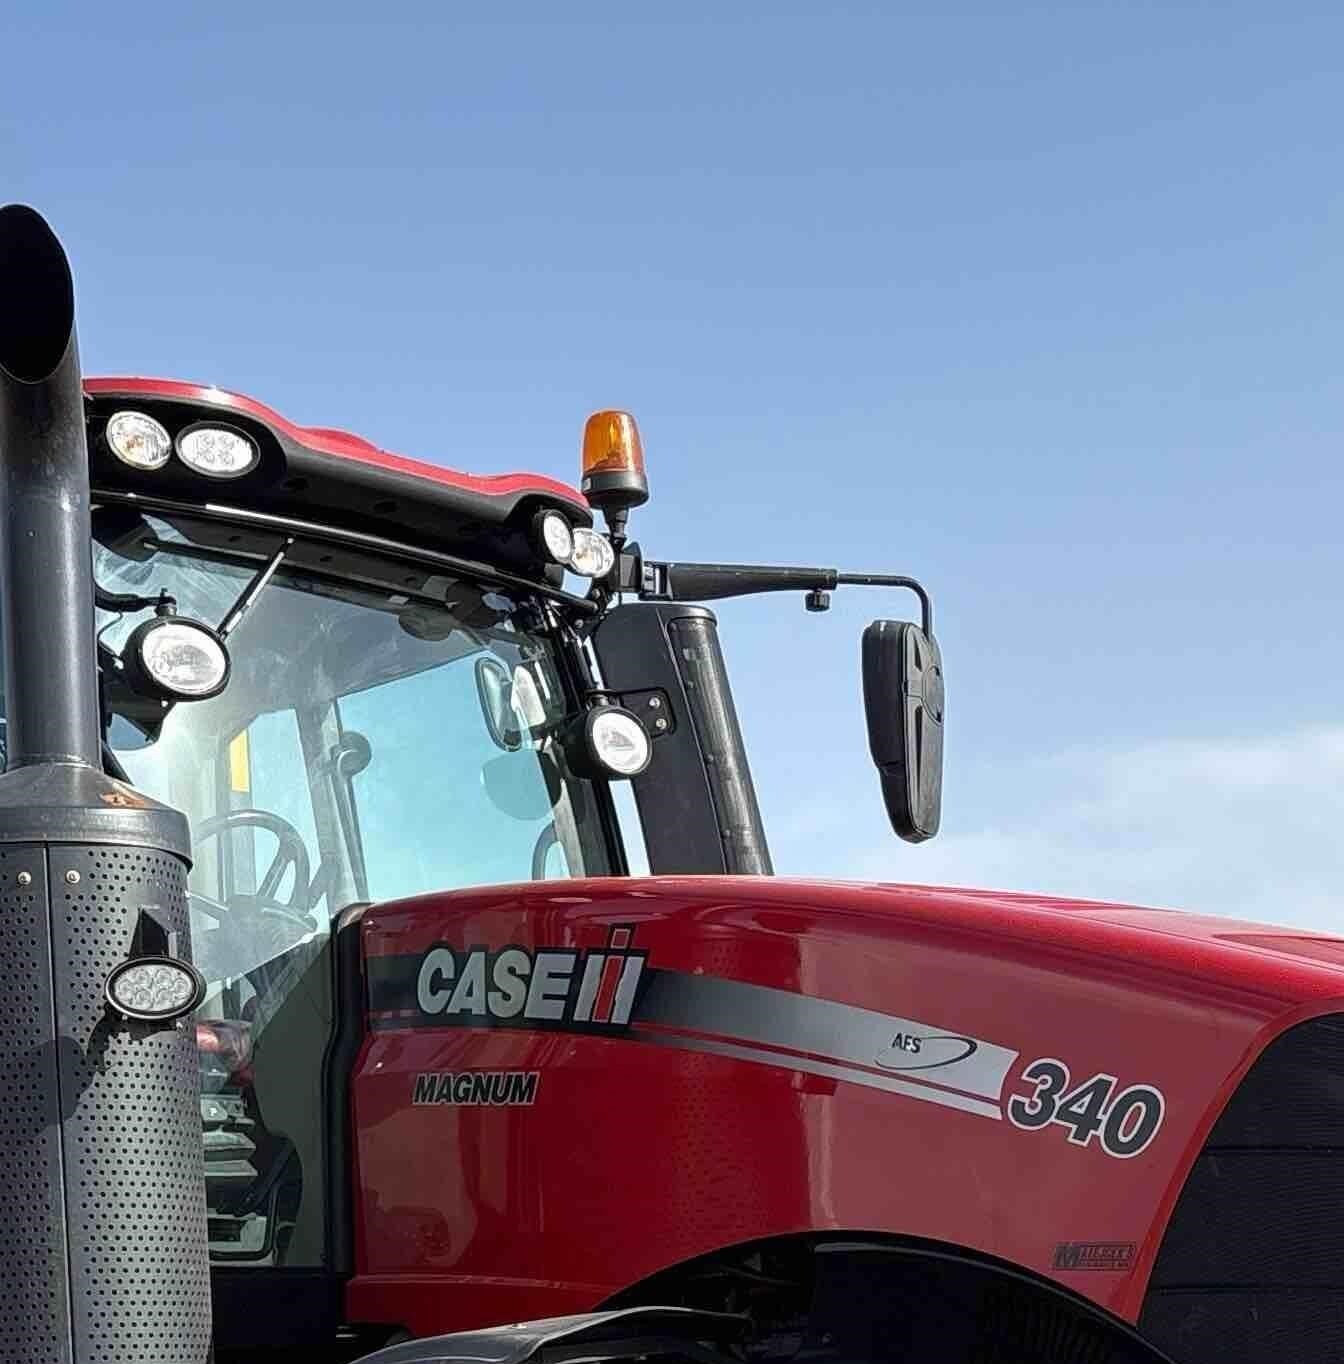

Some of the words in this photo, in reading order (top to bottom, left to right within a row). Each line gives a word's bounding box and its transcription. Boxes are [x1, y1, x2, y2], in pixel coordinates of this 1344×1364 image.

[418, 948, 576, 1019] CASE
[892, 1032, 922, 1053] AFS
[413, 1072, 540, 1105] MAGNUM
[1008, 1058, 1165, 1158] 340
